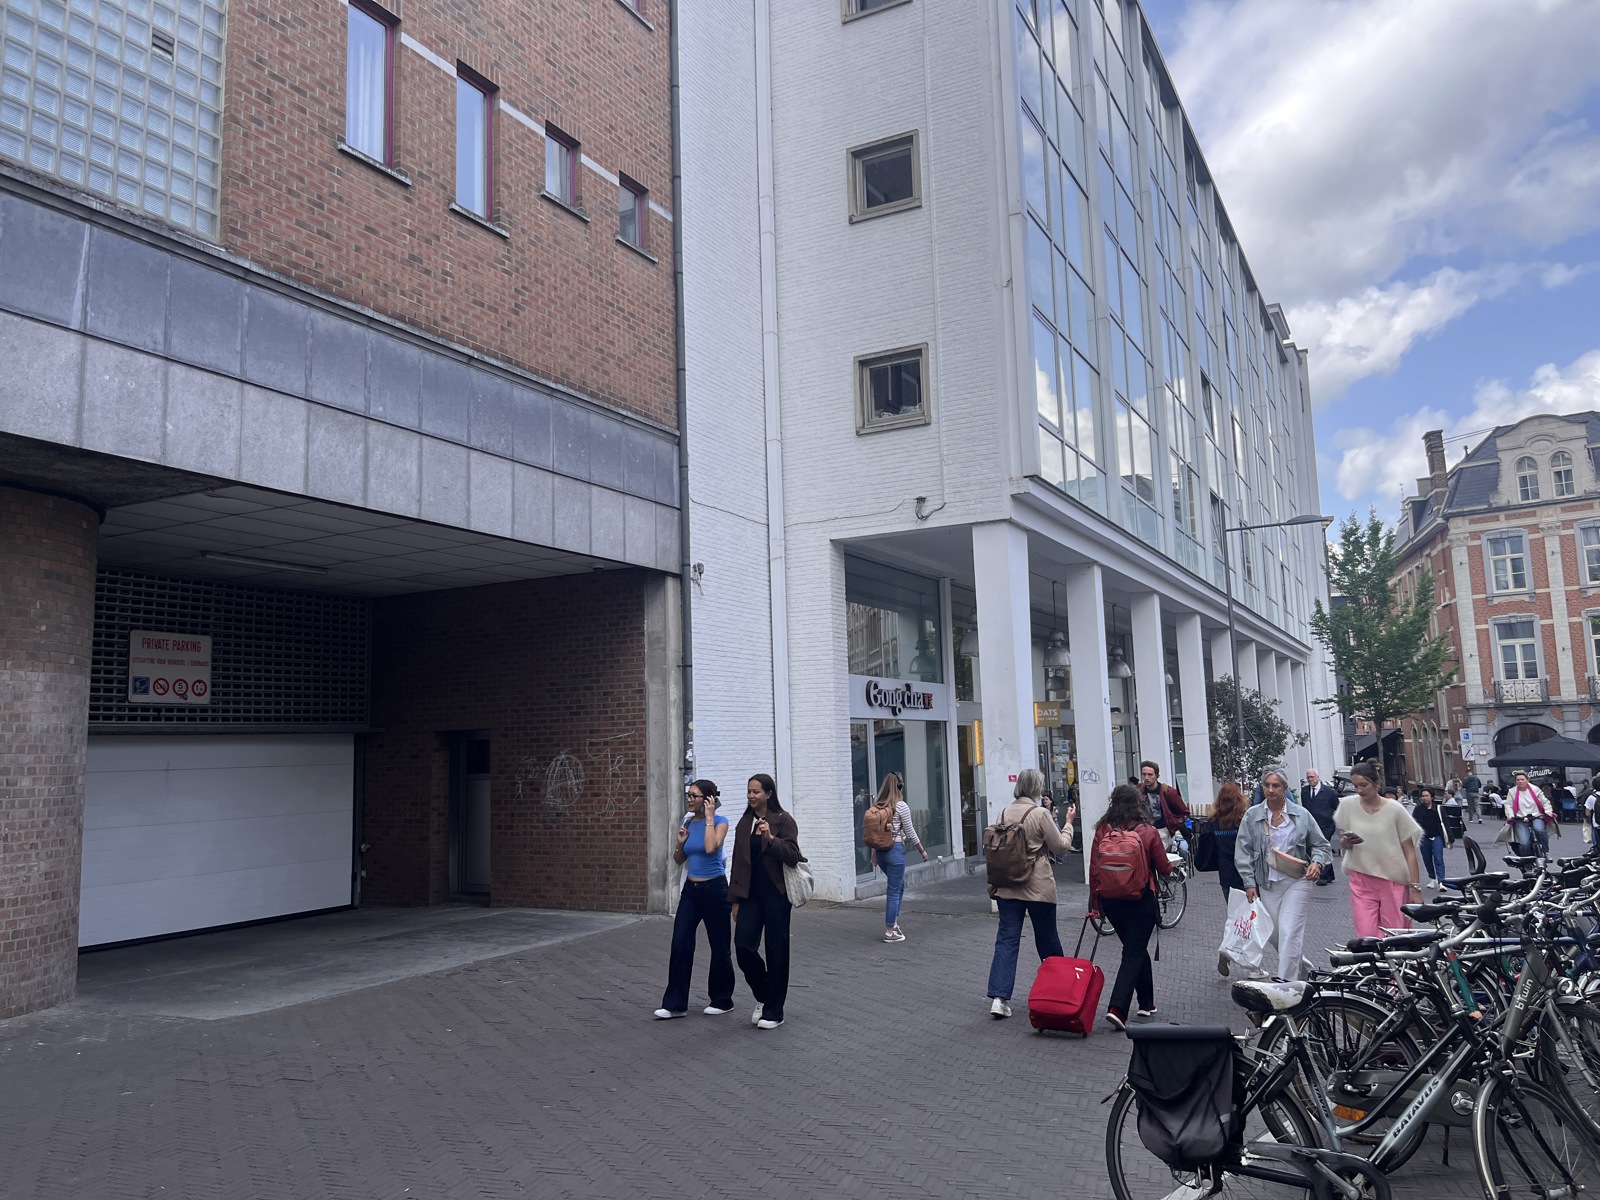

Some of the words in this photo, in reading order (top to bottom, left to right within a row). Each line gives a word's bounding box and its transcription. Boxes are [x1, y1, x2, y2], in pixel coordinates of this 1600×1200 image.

[142, 638, 170, 651] PRIVATE
[172, 640, 202, 652] PARKING
[866, 680, 903, 716] Gong
[903, 683, 924, 709] cha
[1038, 708, 1058, 717] OATS
[1392, 1078, 1440, 1139] BATAVUS
